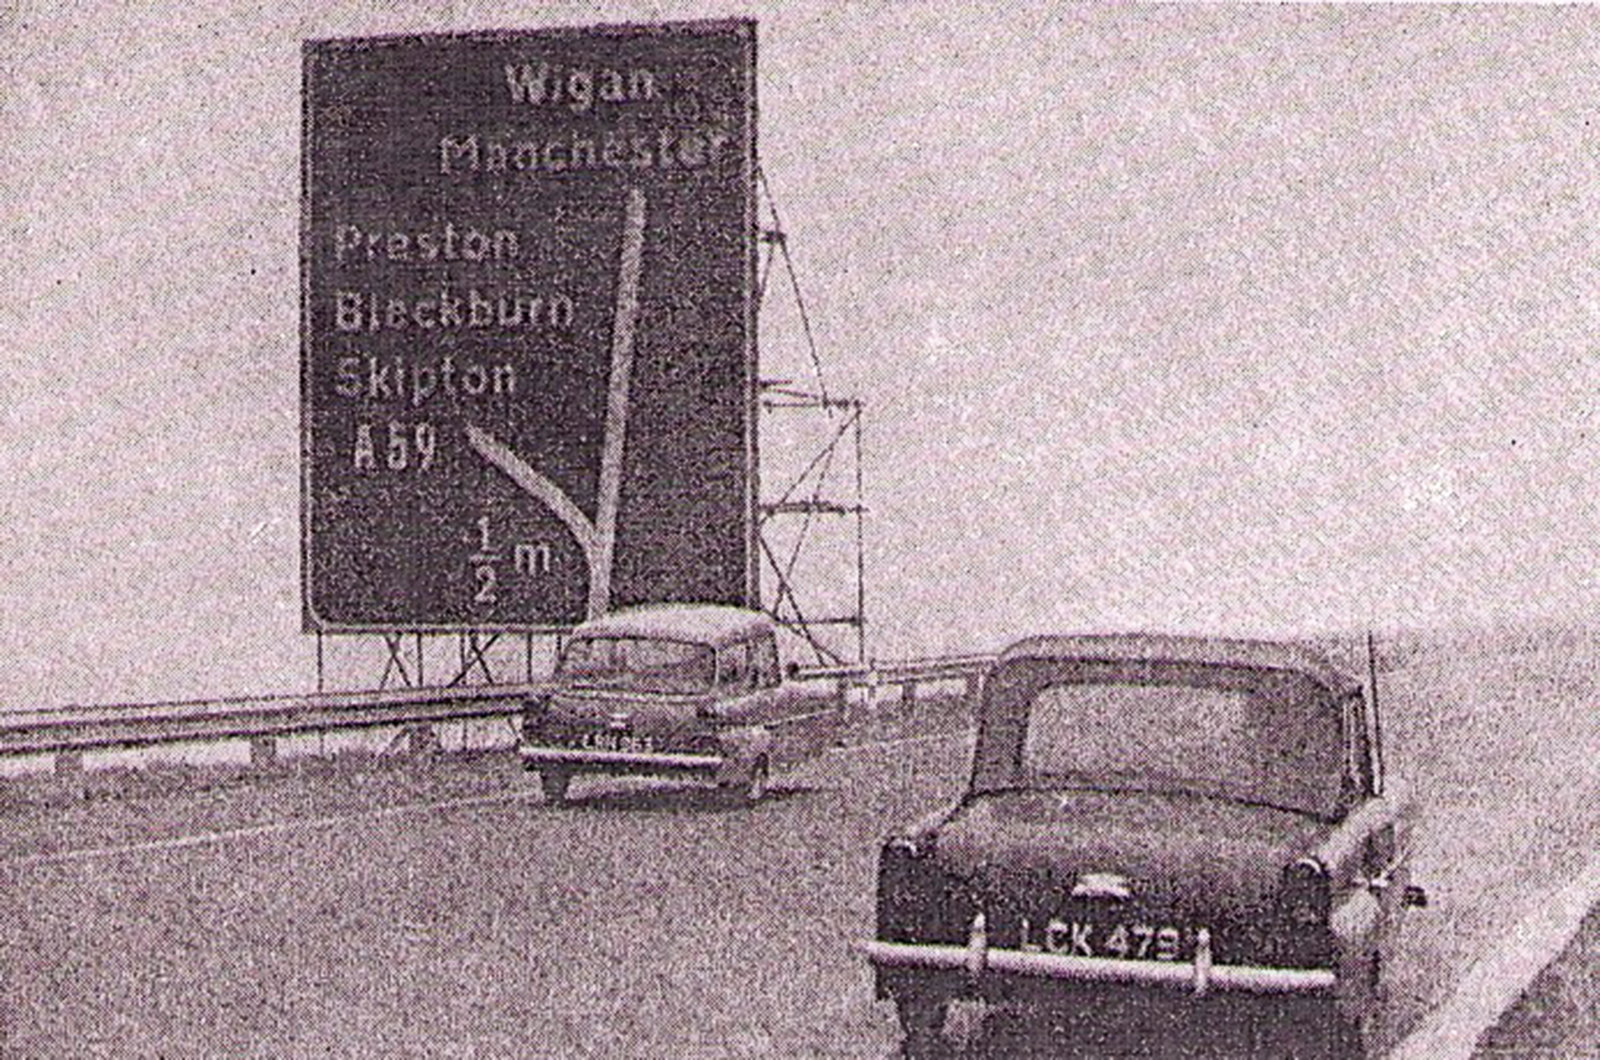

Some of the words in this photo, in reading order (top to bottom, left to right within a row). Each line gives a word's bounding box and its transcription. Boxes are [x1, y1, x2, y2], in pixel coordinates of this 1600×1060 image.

[506, 62, 657, 108] Wigan
[440, 132, 728, 172] Manchester
[336, 224, 519, 265] Preston
[335, 292, 573, 330] Blackburn
[335, 356, 517, 404] Skipton
[354, 421, 436, 472] A59
[514, 541, 552, 577] m
[1021, 919, 1093, 957] LCK
